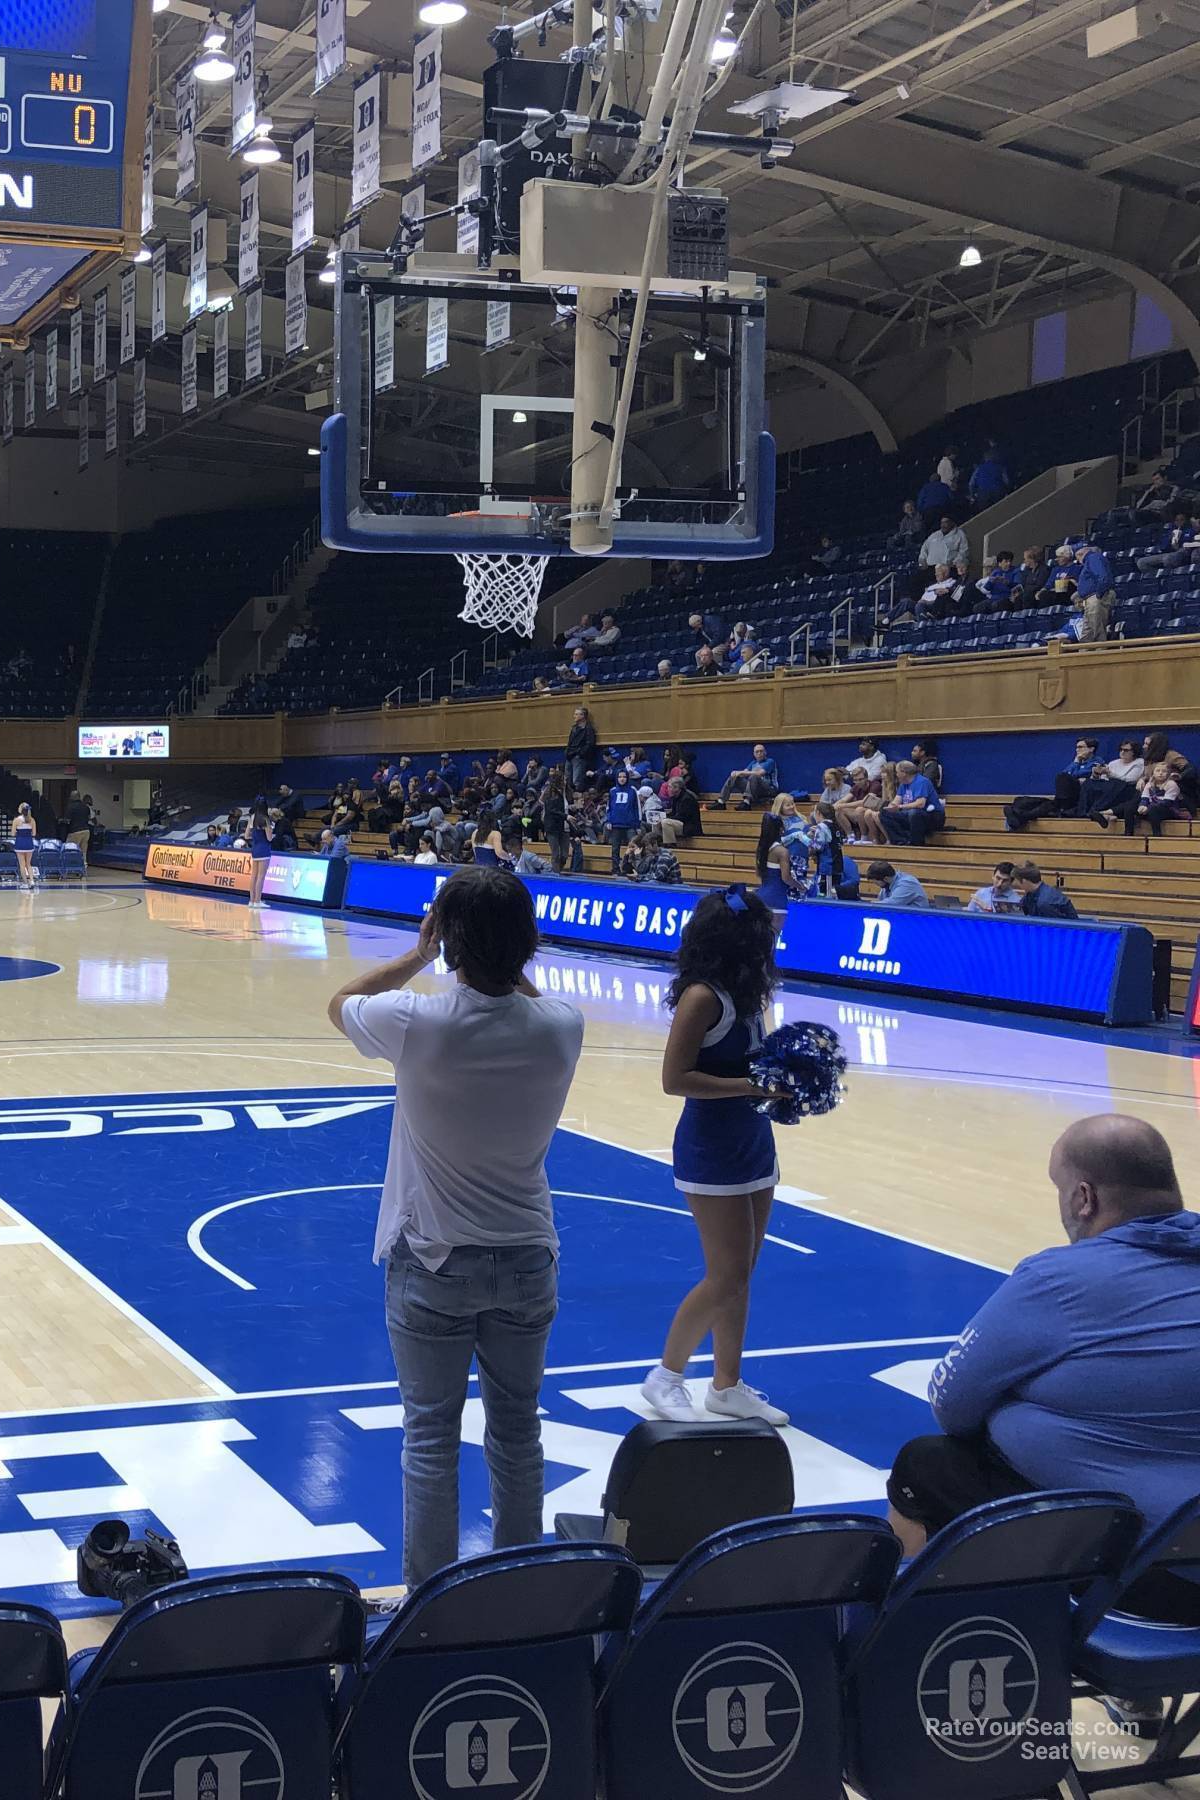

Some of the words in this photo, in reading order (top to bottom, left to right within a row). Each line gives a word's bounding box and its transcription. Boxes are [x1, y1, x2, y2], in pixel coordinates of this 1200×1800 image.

[50, 72, 81, 92] NU
[74, 105, 95, 144] 0
[152, 848, 189, 868] Continental
[203, 852, 246, 876] Continental
[161, 868, 179, 879] TIRE
[213, 876, 236, 887] TIRE
[536, 894, 625, 930] WOMEN'S
